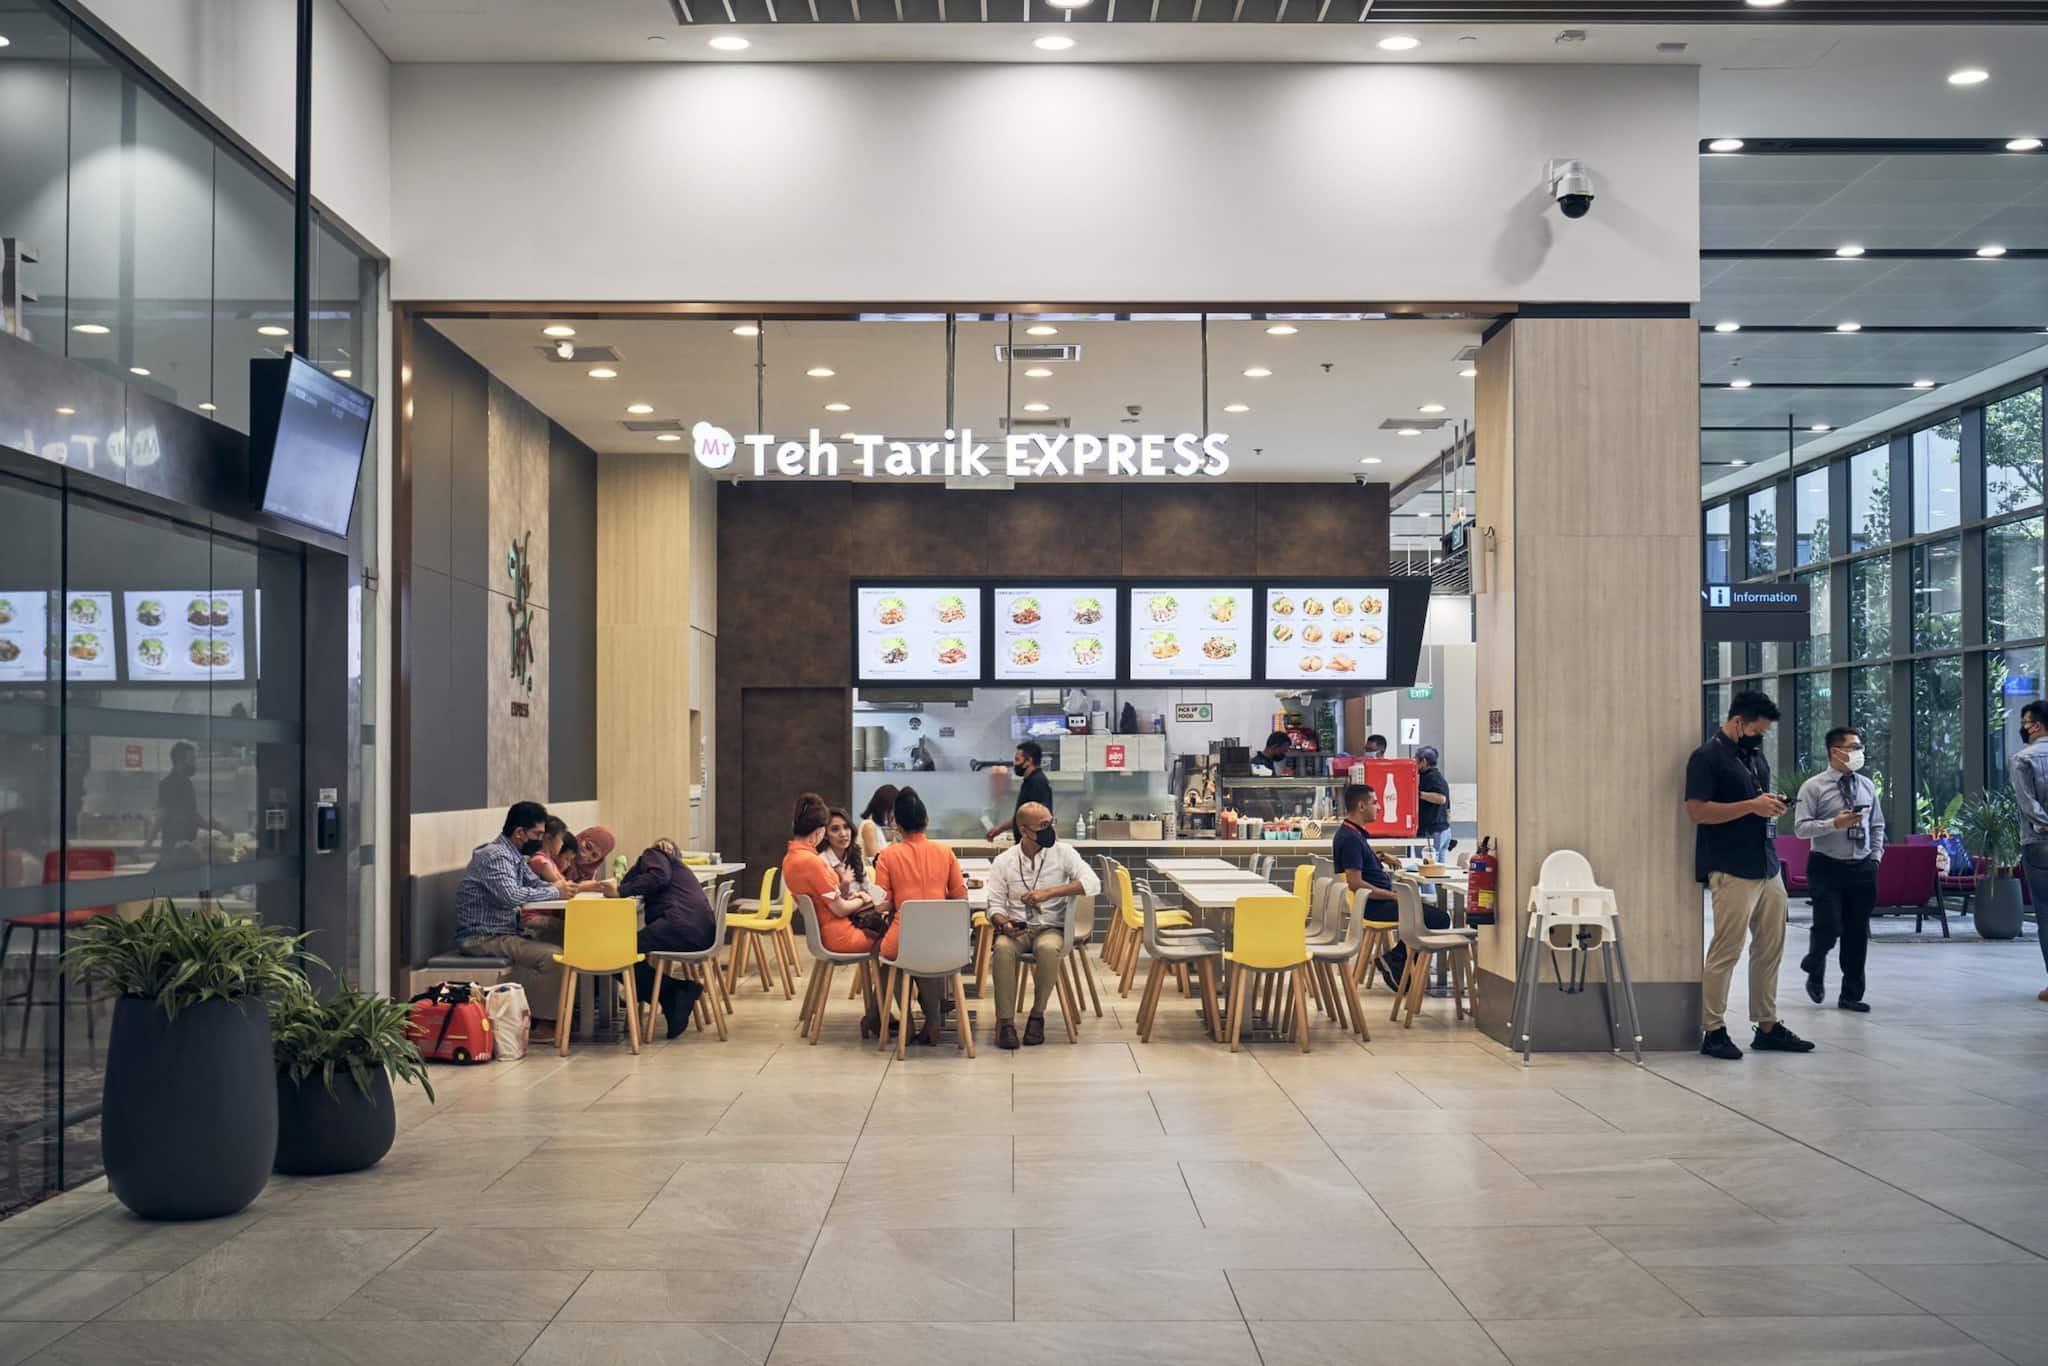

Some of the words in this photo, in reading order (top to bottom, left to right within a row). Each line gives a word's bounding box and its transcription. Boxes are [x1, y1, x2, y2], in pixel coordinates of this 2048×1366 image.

[702, 438, 730, 456] Mr
[744, 428, 838, 476] Teh
[853, 428, 991, 477] Tarik
[1006, 433, 1230, 476] EXPRESS
[1733, 591, 1798, 602] Information
